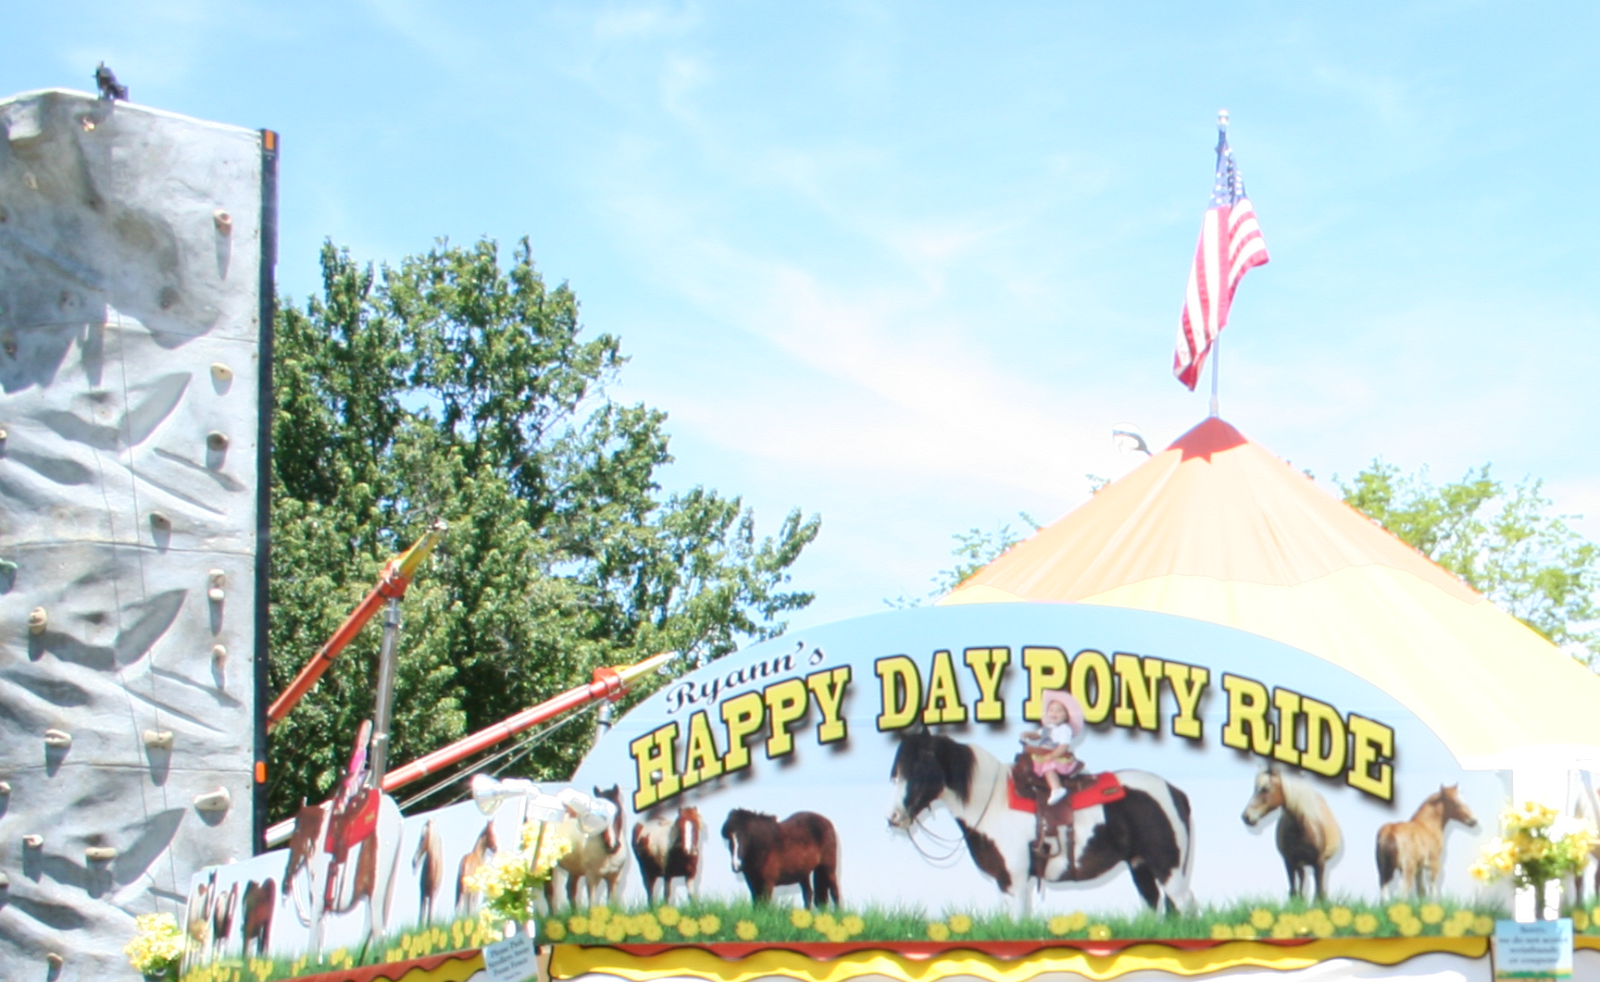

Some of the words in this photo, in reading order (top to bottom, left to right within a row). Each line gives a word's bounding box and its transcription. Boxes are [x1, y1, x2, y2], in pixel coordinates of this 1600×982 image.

[630, 664, 852, 814] HAPPY
[876, 646, 1009, 732] DAY
[1023, 646, 1210, 739] PONY
[1221, 670, 1396, 801] RIDE
[666, 641, 824, 714] Ryann's
